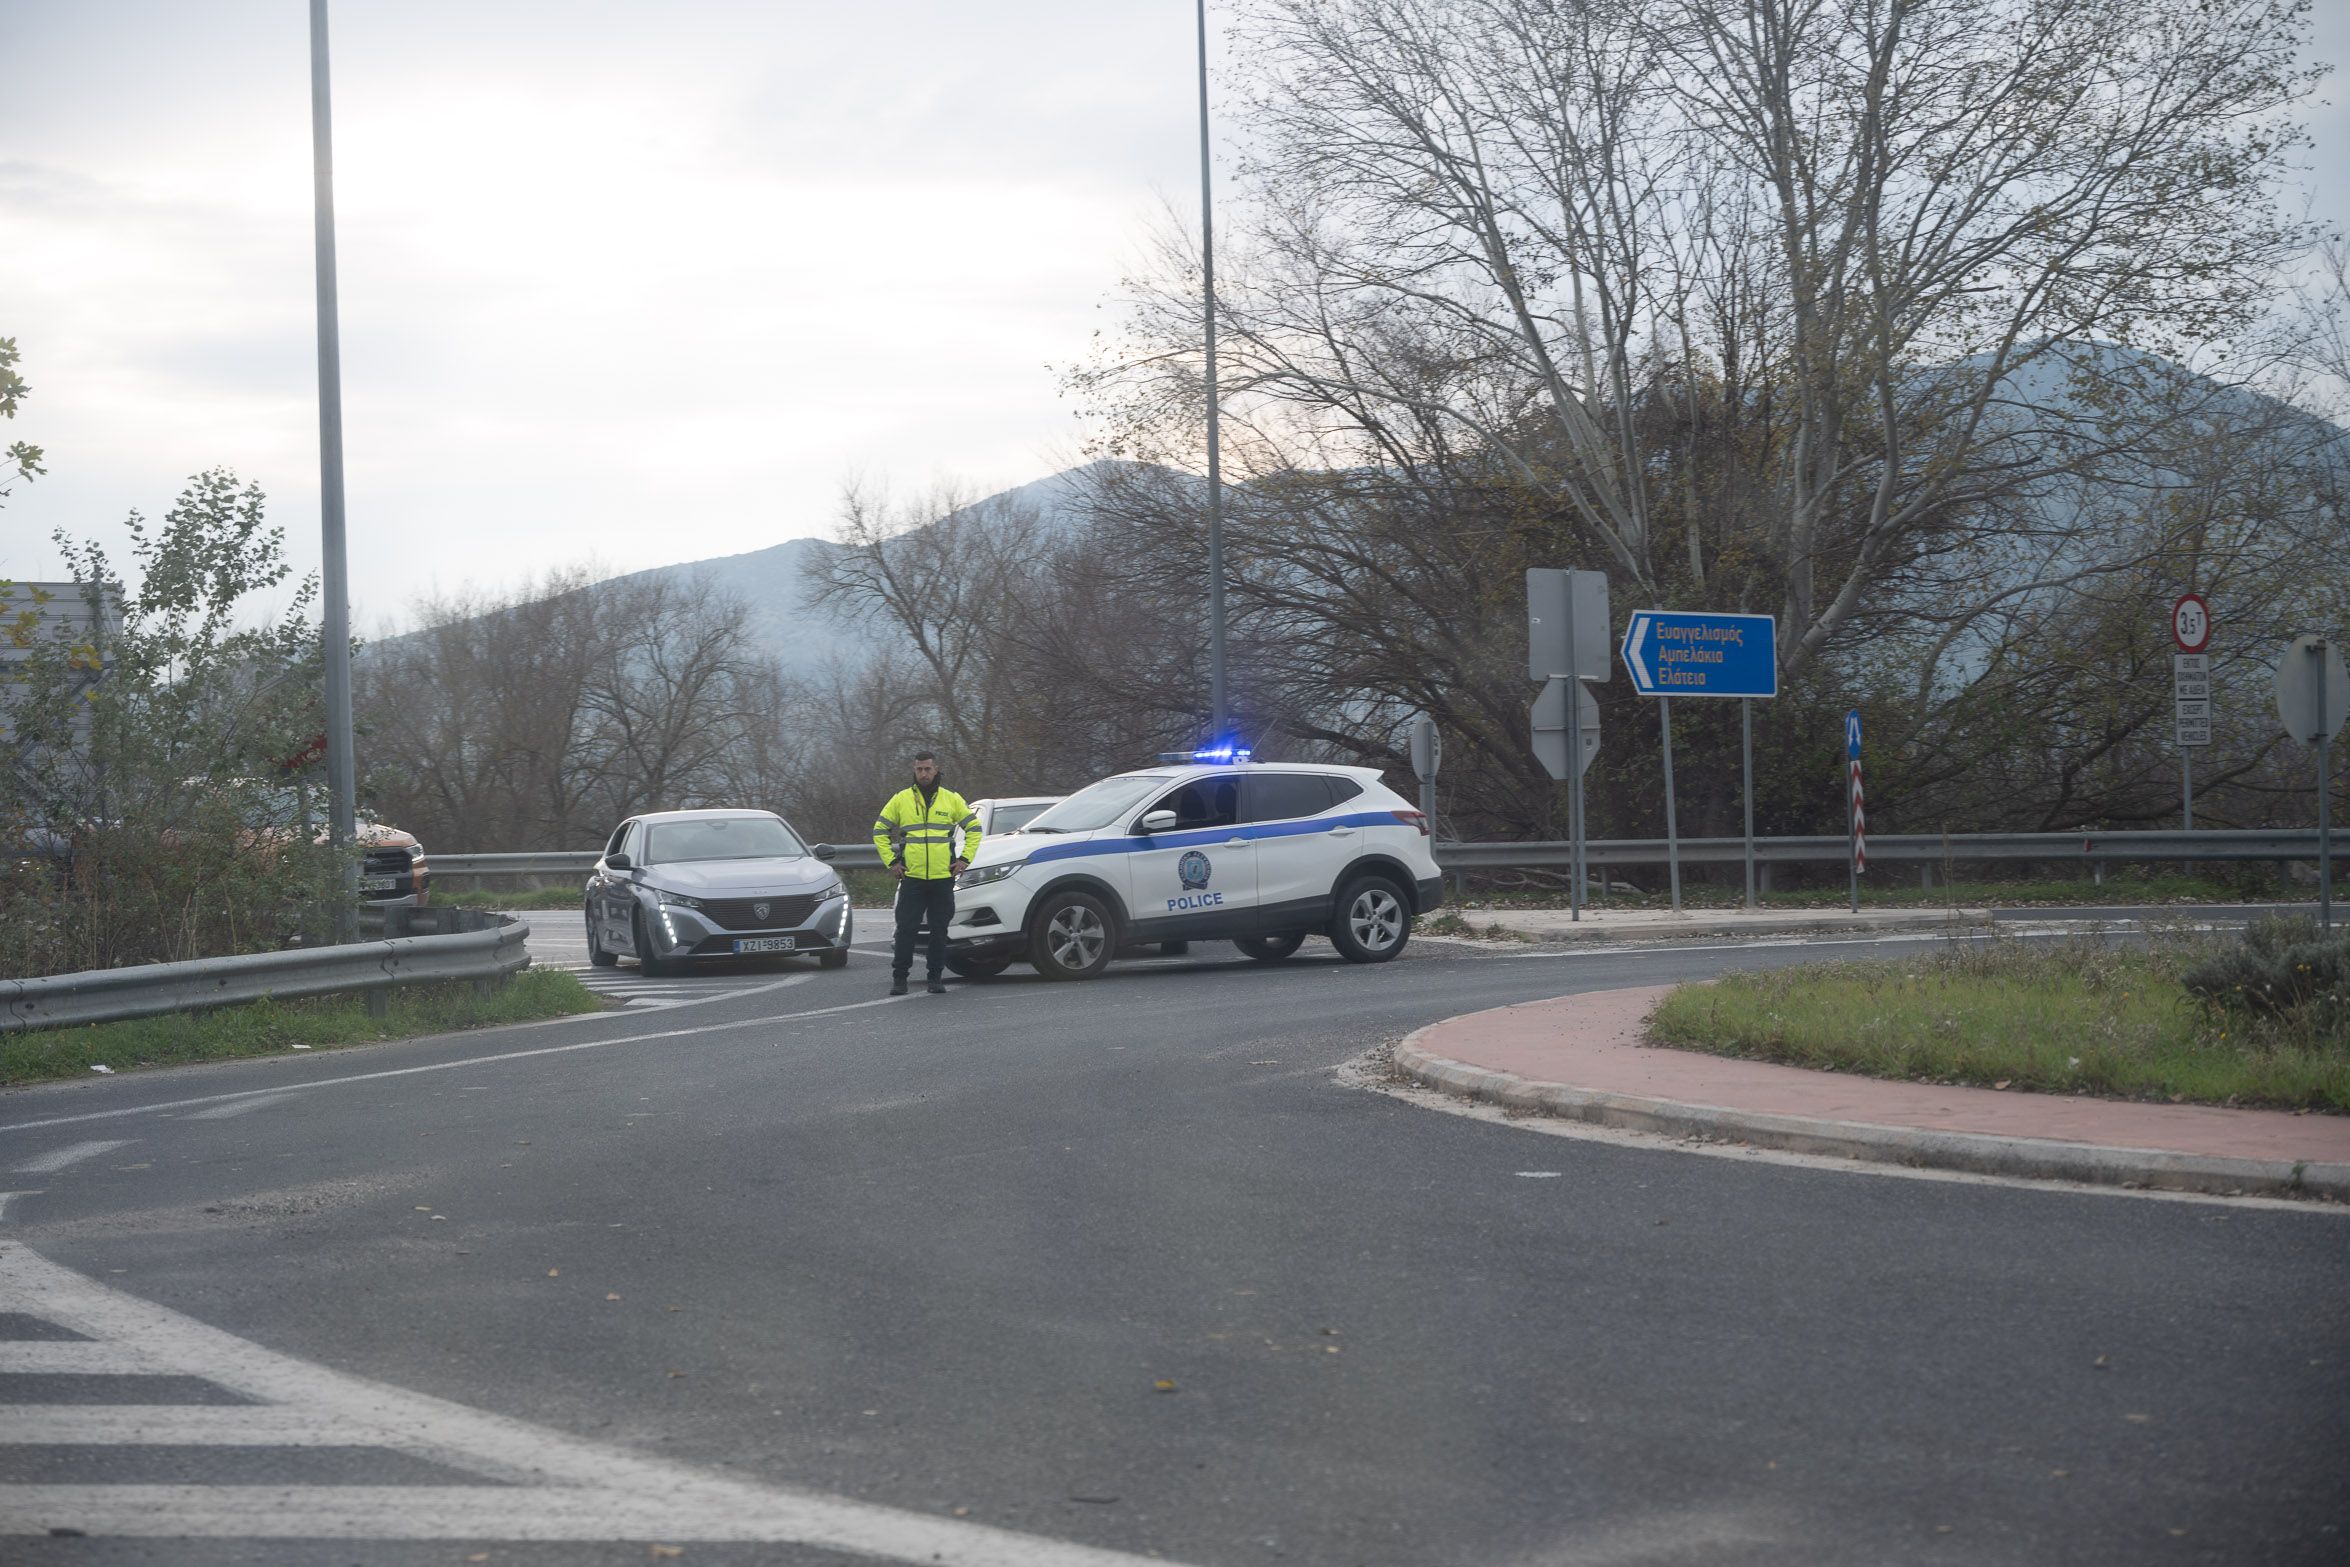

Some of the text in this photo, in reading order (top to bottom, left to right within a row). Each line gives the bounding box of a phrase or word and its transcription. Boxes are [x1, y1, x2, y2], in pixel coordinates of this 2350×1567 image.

[1656, 622, 1744, 647] Ευαγγελισμός
[1658, 645, 1724, 665] Αμπελάκια
[1658, 667, 1707, 686] Ελάτεια
[1167, 892, 1224, 911] POLICE
